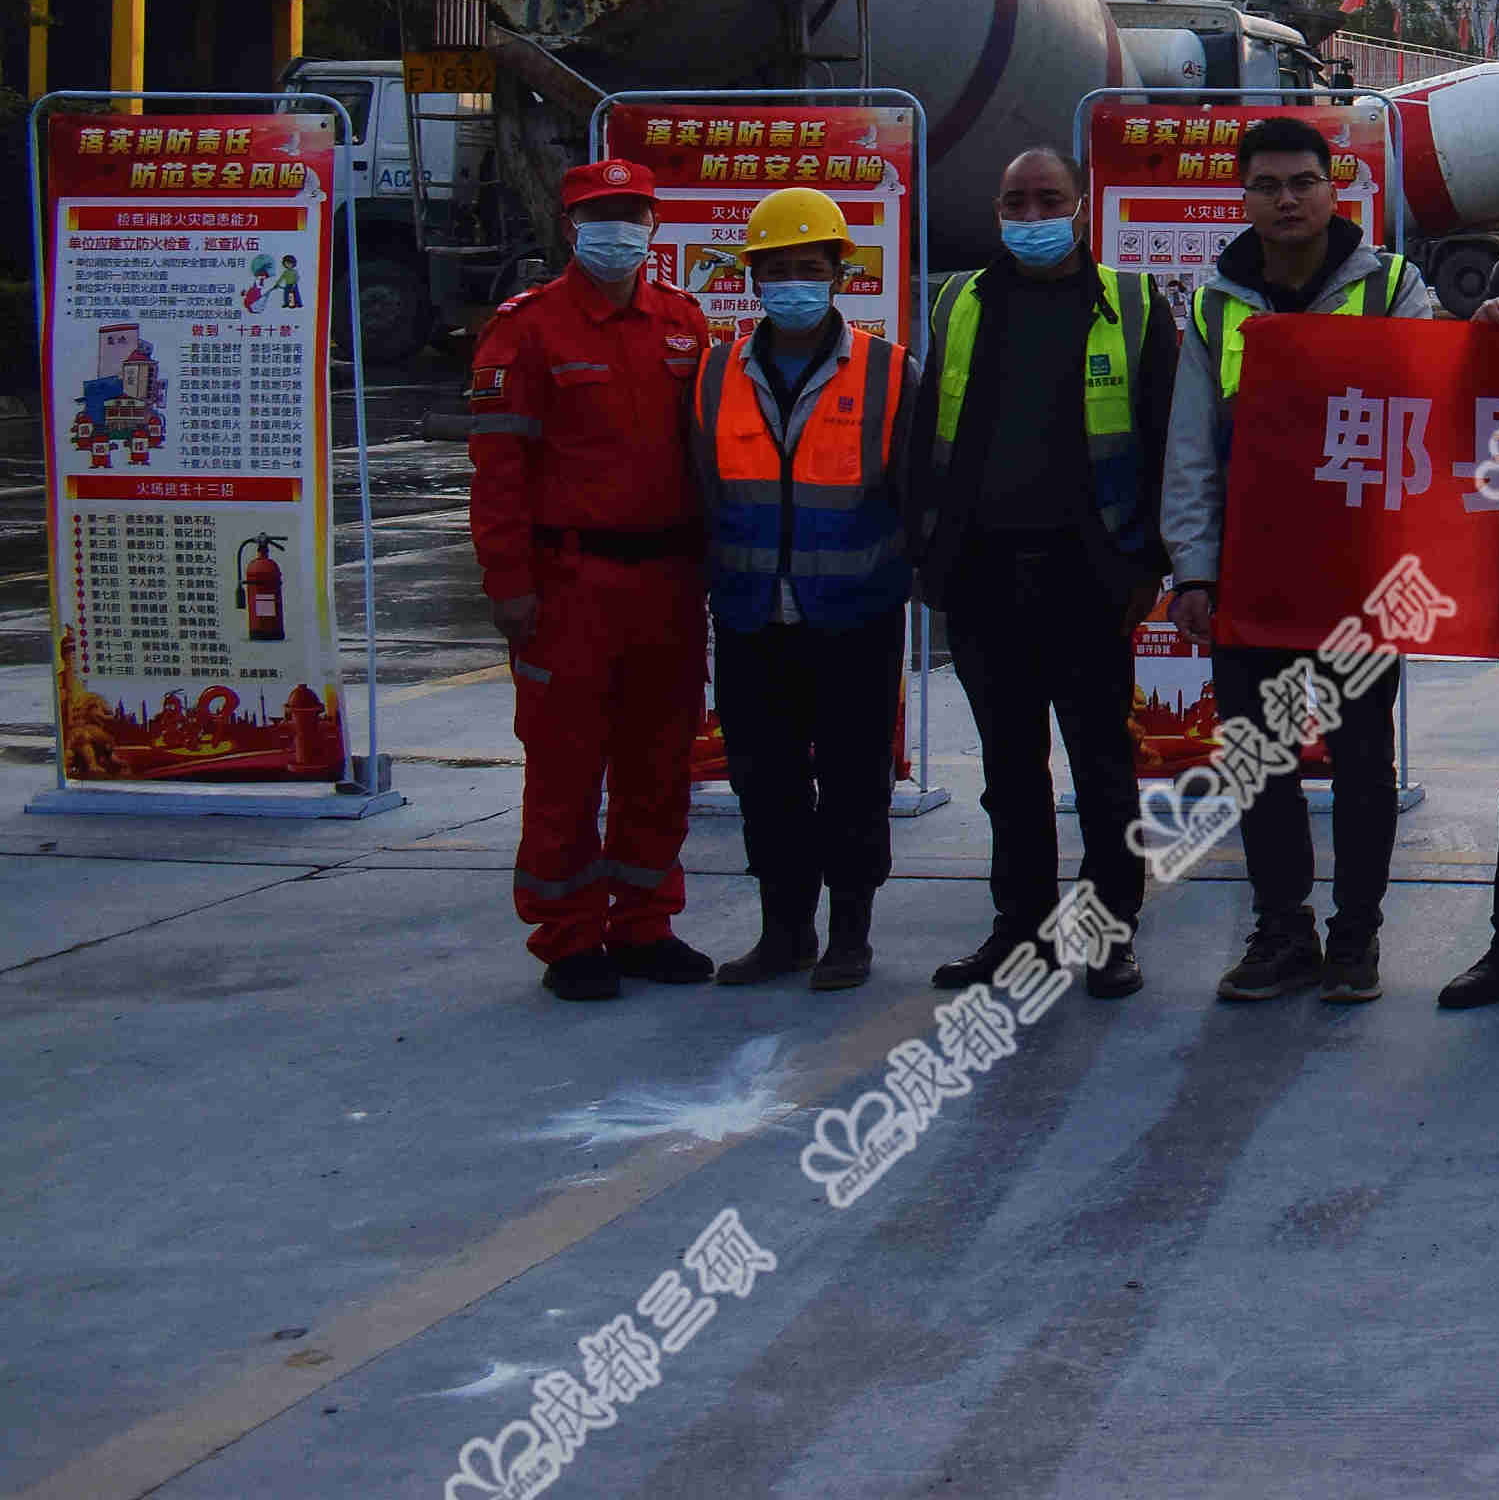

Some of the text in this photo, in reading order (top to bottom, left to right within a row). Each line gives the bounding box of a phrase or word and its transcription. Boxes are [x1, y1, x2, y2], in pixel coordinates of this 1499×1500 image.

[78, 128, 252, 155] 落实消防责任
[646, 118, 826, 147] 落实消防责任
[130, 162, 306, 189] 防范安全风险
[700, 155, 885, 182] 防范安全风险
